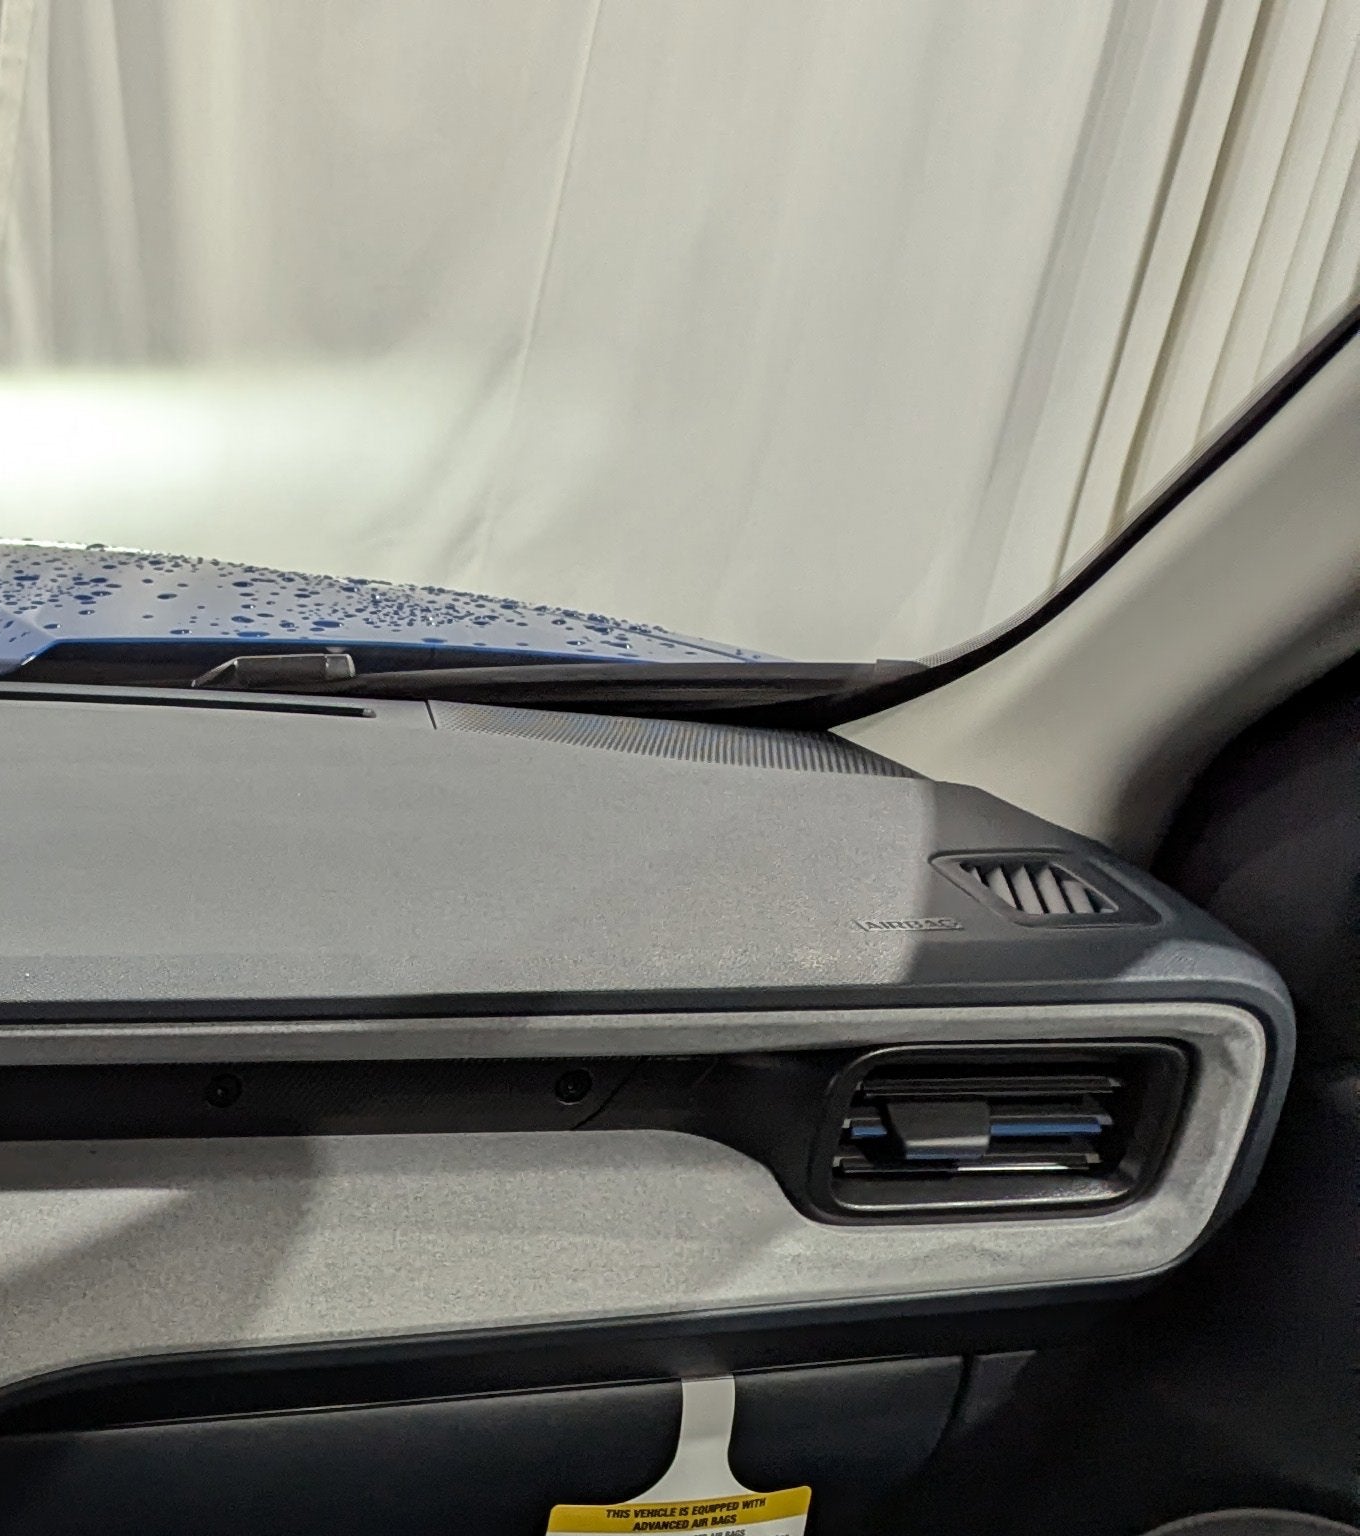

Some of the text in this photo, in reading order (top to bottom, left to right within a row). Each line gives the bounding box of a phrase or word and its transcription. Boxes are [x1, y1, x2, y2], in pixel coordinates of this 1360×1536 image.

[606, 1498, 767, 1518] THIS VEHICLE IS EQUIPPED WITH
[633, 1514, 737, 1531] ADVANCED AIR BAGS
